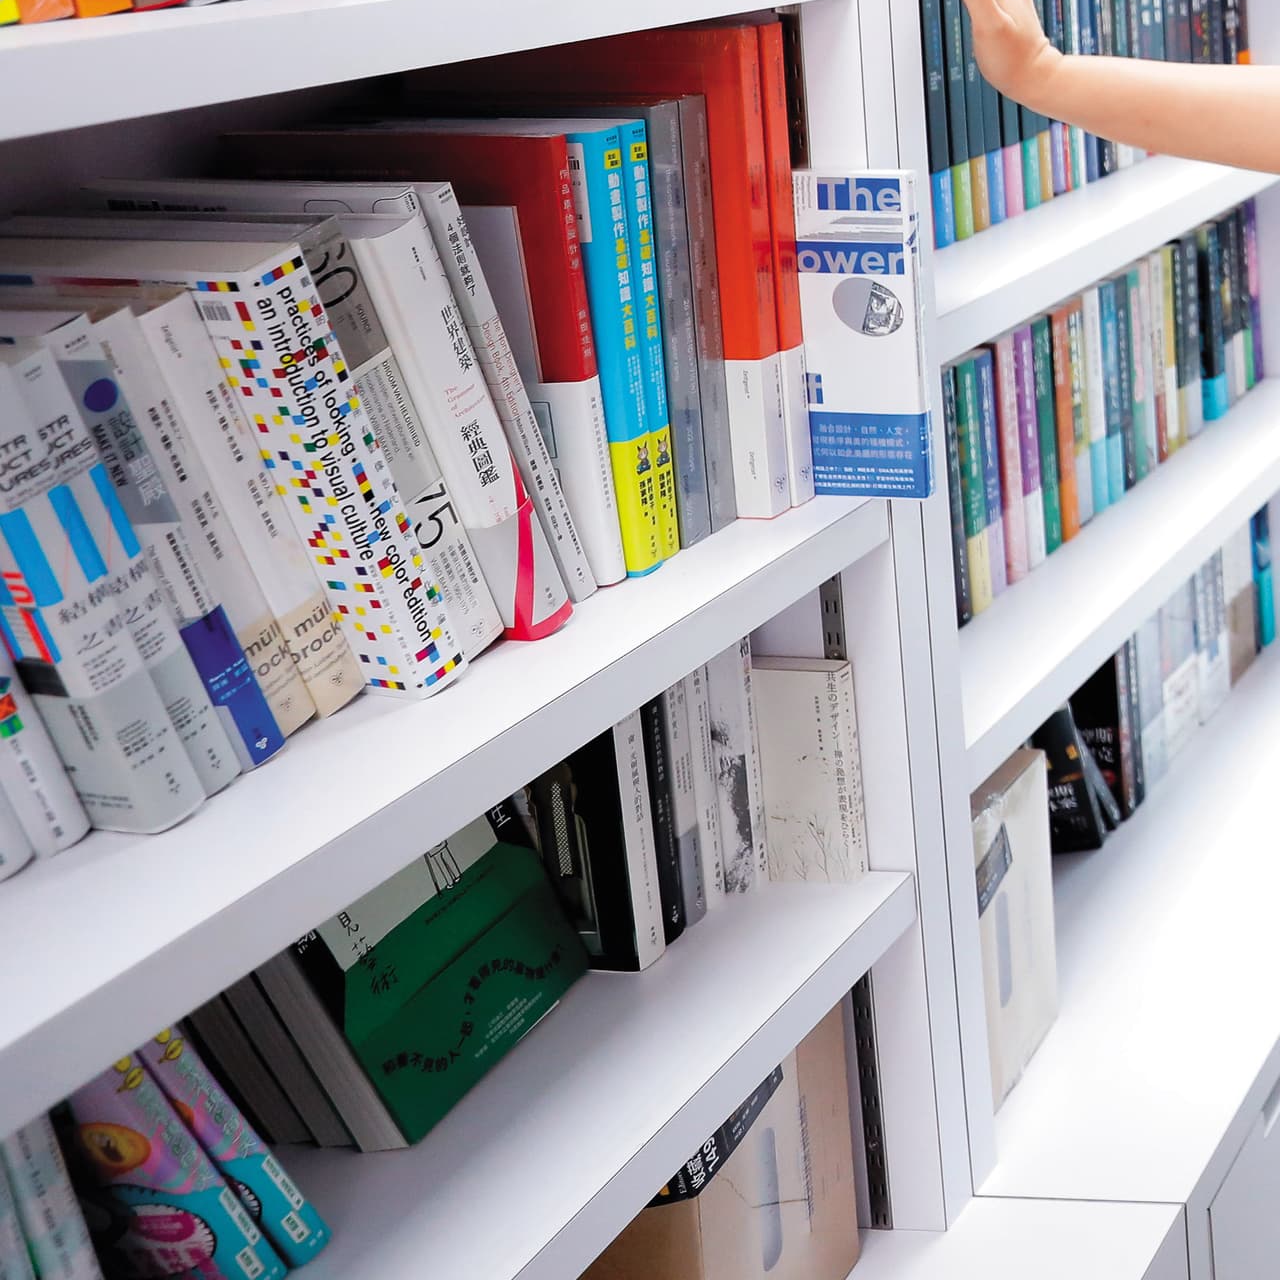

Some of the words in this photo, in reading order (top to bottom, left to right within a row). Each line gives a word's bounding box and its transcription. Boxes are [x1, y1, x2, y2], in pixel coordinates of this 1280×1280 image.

[817, 177, 901, 211] The
[797, 248, 905, 274] ower
[257, 297, 274, 320] an
[276, 285, 318, 369] practices
[440, 304, 474, 374] 世界建築
[267, 323, 320, 429] introduction
[313, 370, 330, 391] of
[311, 429, 329, 449] to
[321, 389, 356, 458] looking
[459, 418, 501, 489] 經典圖鑑
[319, 448, 344, 502] visual
[340, 502, 374, 562] culture
[414, 483, 459, 549] 75
[369, 508, 391, 541] new
[385, 545, 412, 585] color
[403, 584, 432, 643] edition
